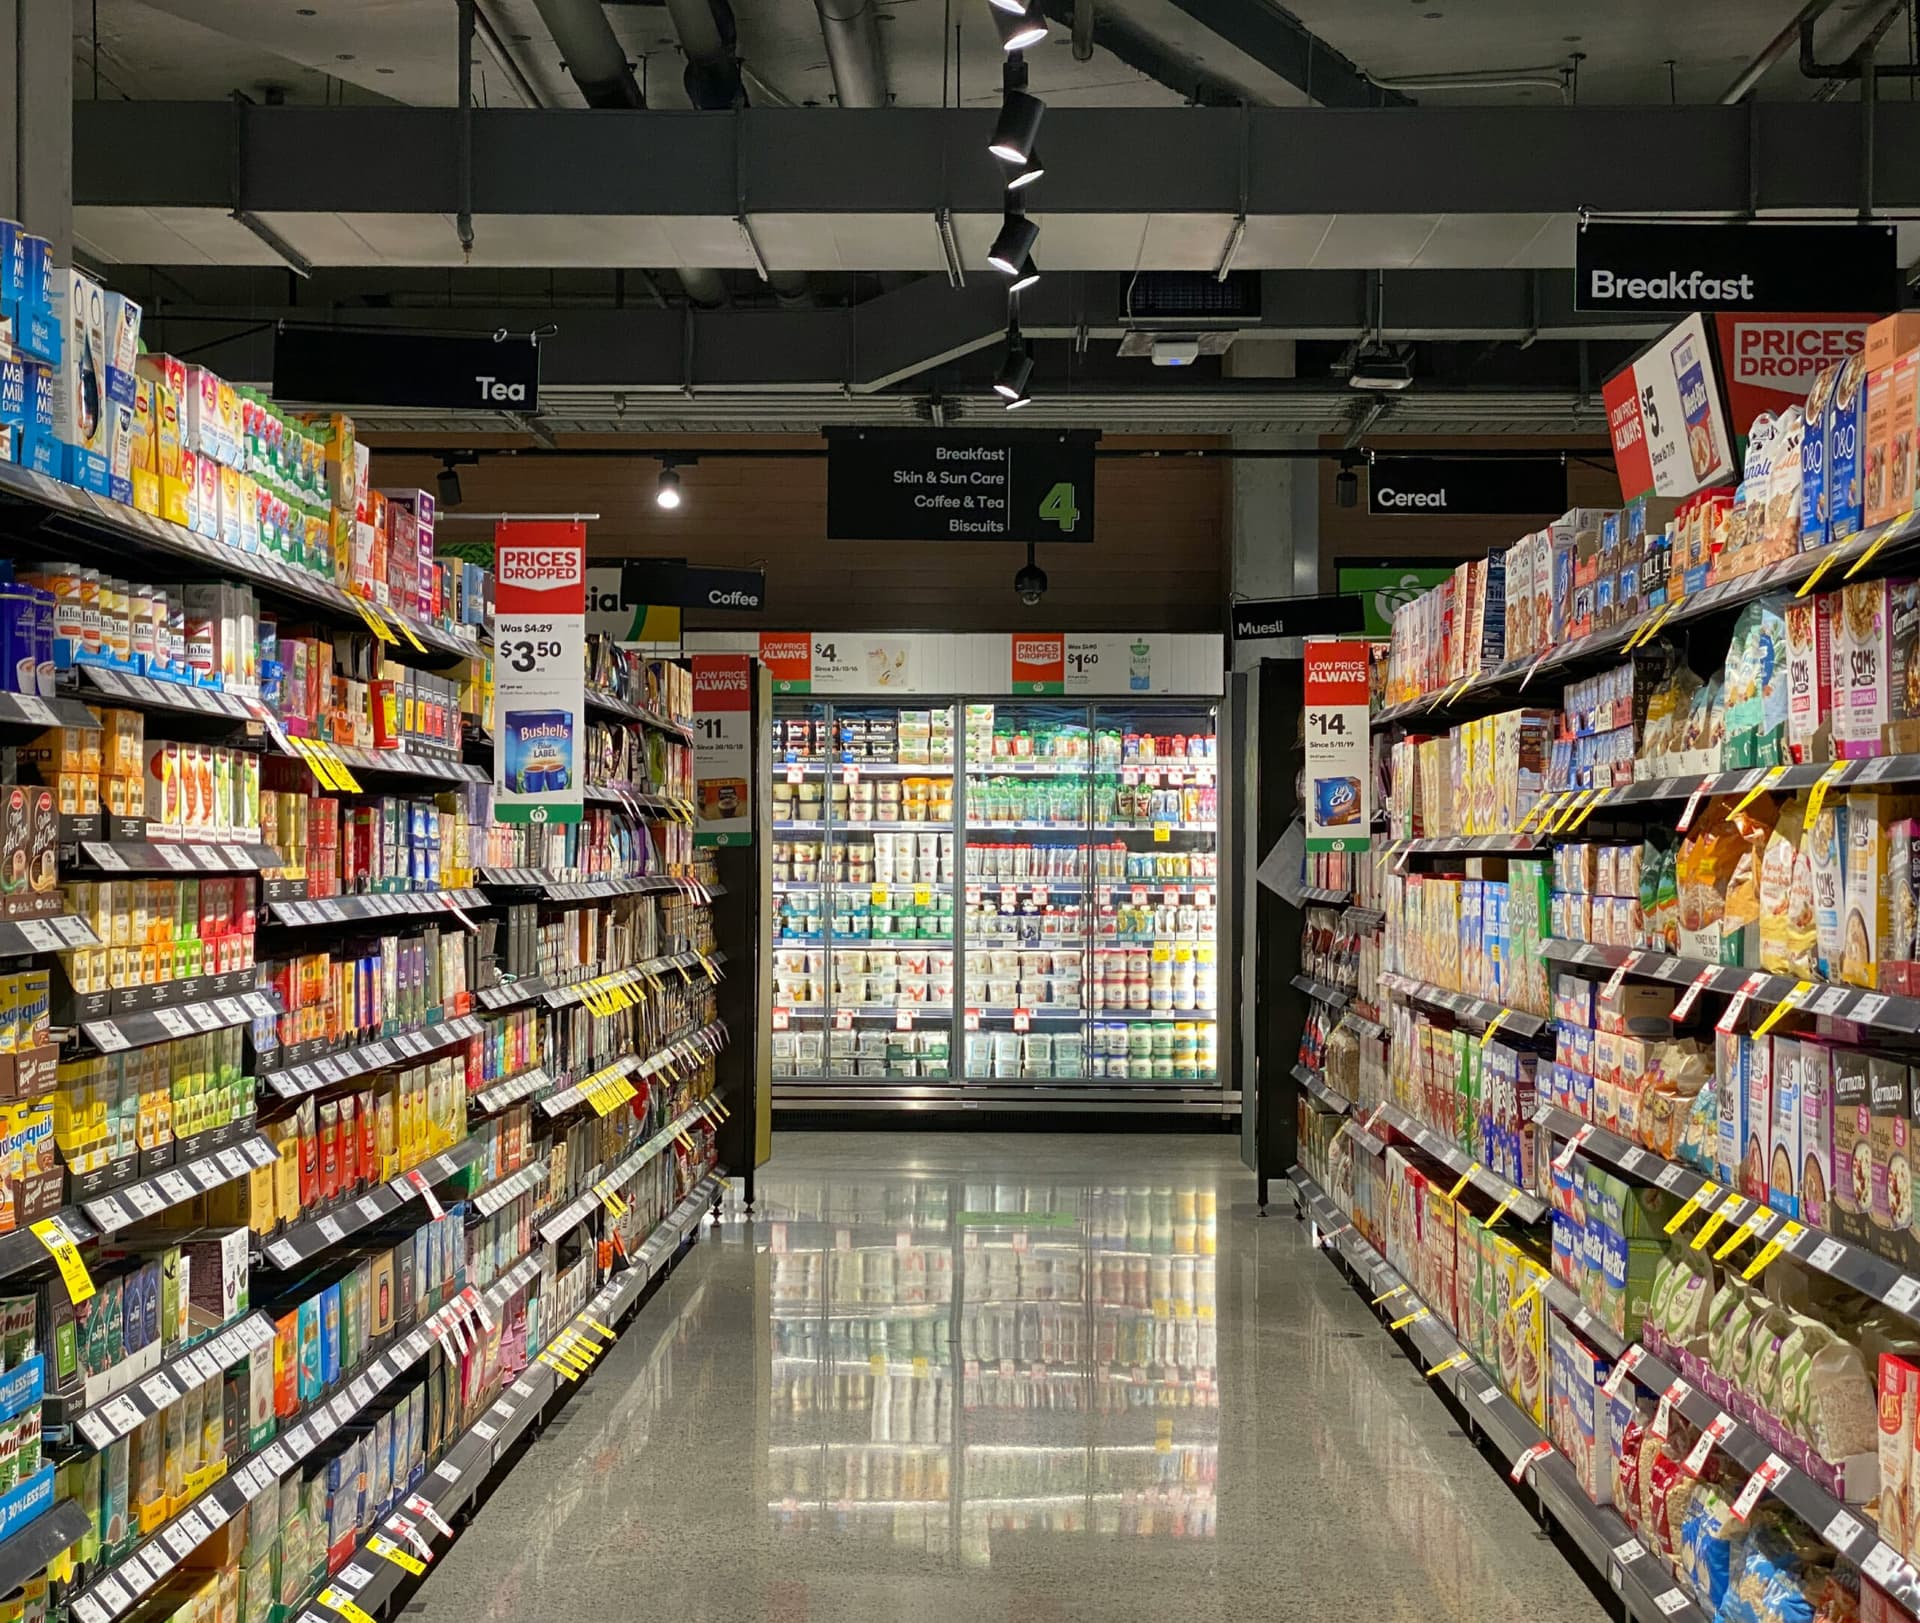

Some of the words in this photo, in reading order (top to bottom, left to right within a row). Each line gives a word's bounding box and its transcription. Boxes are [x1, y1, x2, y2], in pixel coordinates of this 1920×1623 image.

[1591, 270, 1754, 300] Breakfast
[1740, 330, 1865, 355] PRICES
[1740, 357, 1841, 377] DROPP
[476, 376, 525, 401] Tea
[1615, 415, 1642, 452] ALWAYS
[936, 448, 1005, 461] Breakfast
[893, 471, 923, 485] Skin
[926, 472, 937, 484] &
[940, 472, 967, 484] Sun
[970, 472, 1005, 485] Care
[914, 495, 960, 508] Coffee
[963, 496, 974, 508] &
[977, 496, 1005, 509] Tea
[1377, 488, 1447, 507] Cereal
[1039, 482, 1079, 532] 4
[949, 519, 1005, 533] Biscuits
[503, 551, 577, 567] PRICES
[503, 568, 577, 580] DROPPED
[708, 590, 759, 606] Coffee
[500, 624, 522, 633] Was
[524, 624, 553, 633] $4.29
[1238, 620, 1284, 635] Muesli
[763, 650, 808, 660] ALWAYS
[815, 643, 837, 662] $4
[1018, 644, 1059, 653] PRICES
[1308, 662, 1333, 671] LOW
[1334, 661, 1365, 671] PRICE
[695, 672, 719, 681] LOW
[719, 671, 747, 680] PRICE
[1308, 671, 1366, 683] ALWAYS
[695, 680, 748, 691] ALWAYS
[521, 722, 569, 741] Bushells
[696, 718, 721, 739] $11
[1309, 713, 1345, 735] $14
[533, 748, 557, 758] LABEL
[1836, 1066, 1865, 1093] Carman's
[1872, 1076, 1902, 1104] Carman's
[19, 1420, 41, 1439] MIL
